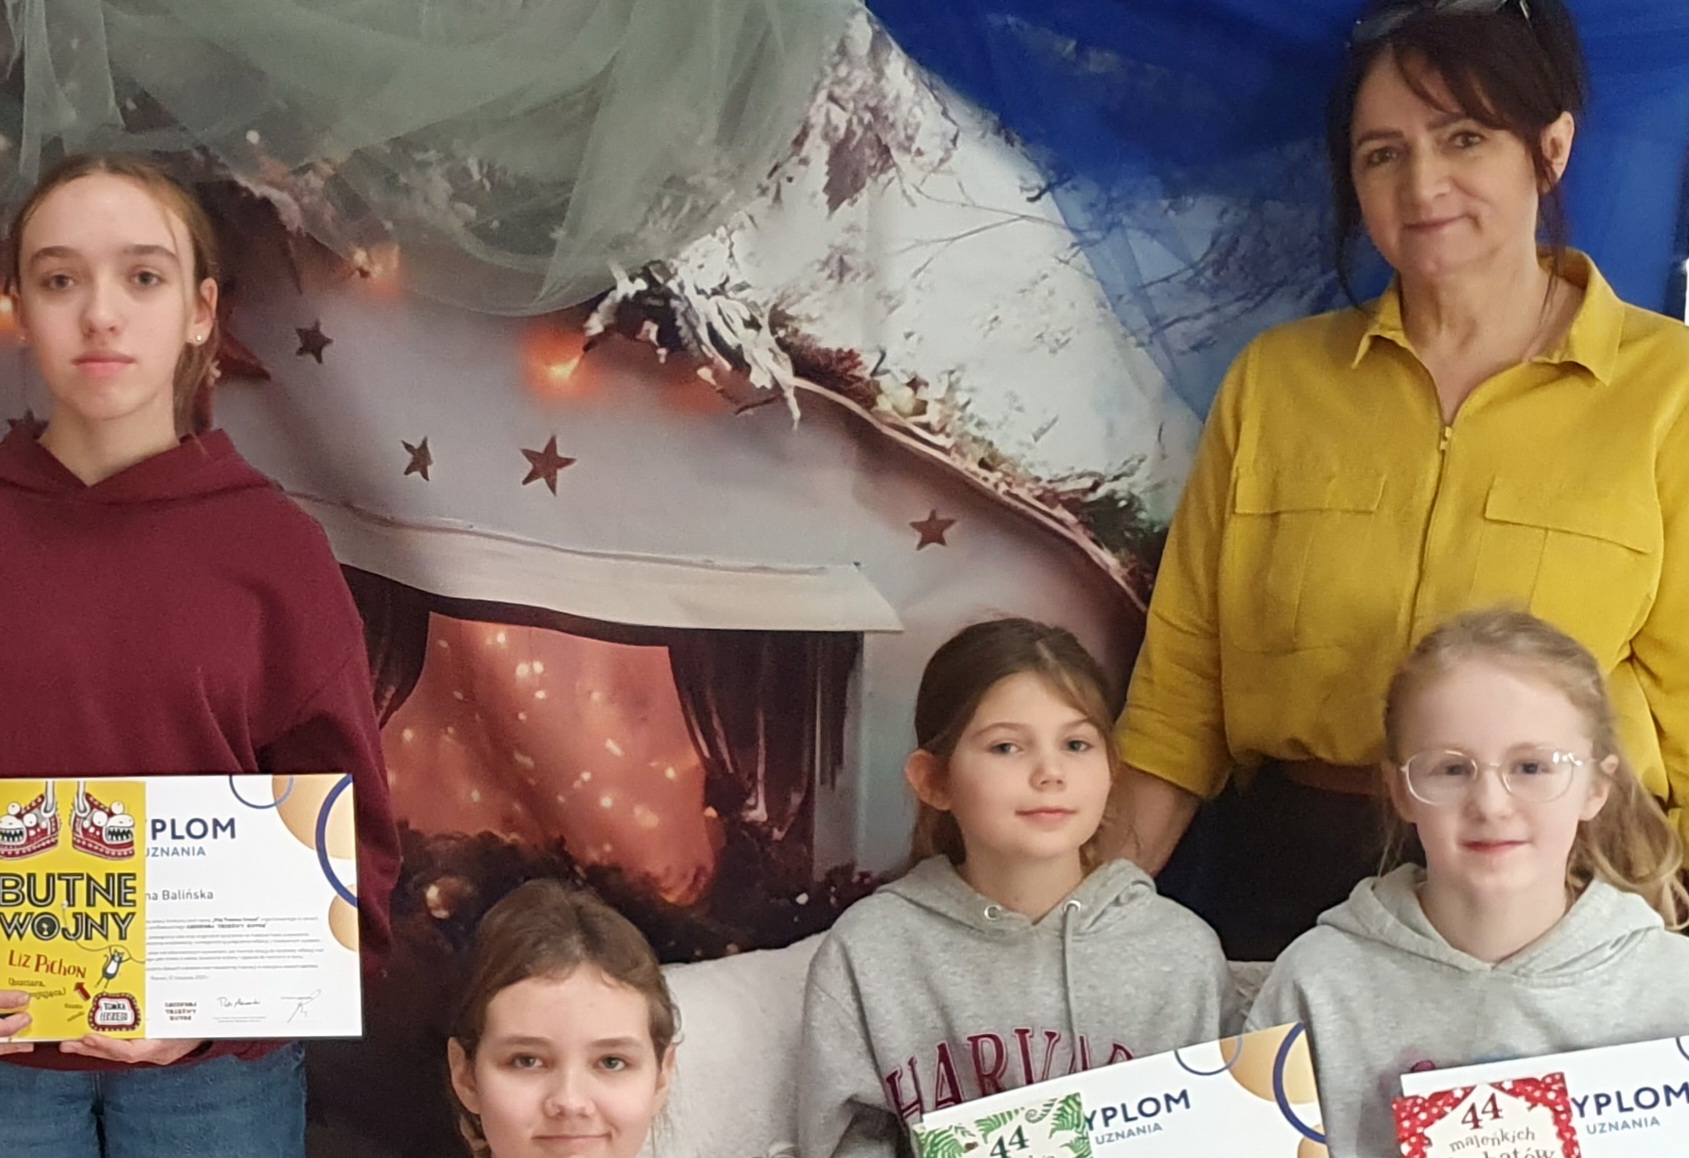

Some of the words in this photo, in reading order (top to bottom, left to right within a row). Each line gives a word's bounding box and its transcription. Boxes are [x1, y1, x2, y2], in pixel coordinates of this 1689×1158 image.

[150, 817, 236, 841] PLOM
[162, 888, 214, 901] Balińska
[885, 1027, 1134, 1125] HARV
[1084, 1088, 1191, 1131] YPLOM
[1461, 1092, 1504, 1130] 44
[1571, 1081, 1689, 1118] YPLOM
[1095, 1122, 1163, 1145] UZNANIA
[1586, 1116, 1661, 1135] UZNANIA
